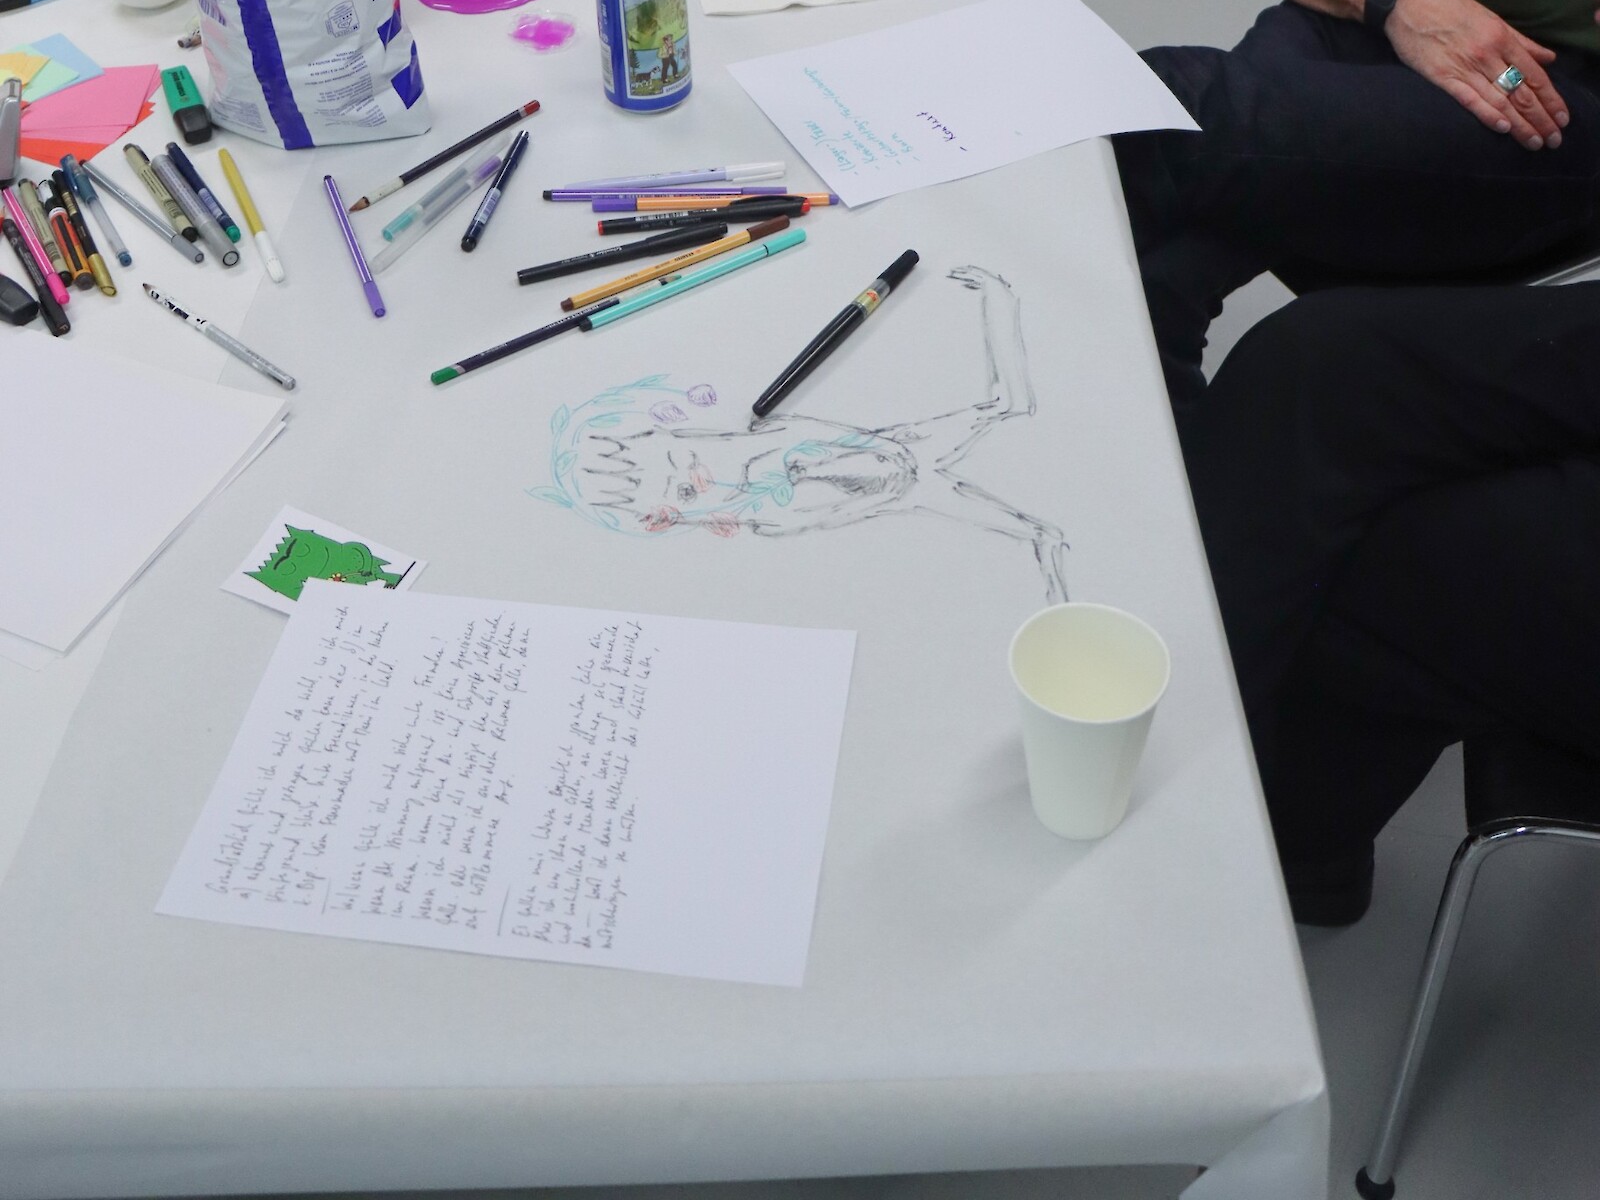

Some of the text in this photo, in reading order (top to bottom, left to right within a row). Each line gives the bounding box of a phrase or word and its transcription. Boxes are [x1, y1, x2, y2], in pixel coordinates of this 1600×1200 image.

[257, 765, 277, 780] ich
[271, 731, 292, 757] mich
[284, 708, 304, 722] da
[318, 636, 338, 650] ich
[335, 606, 349, 631] mich
[369, 797, 390, 814] ich
[267, 810, 287, 835] und
[425, 856, 445, 877] ich
